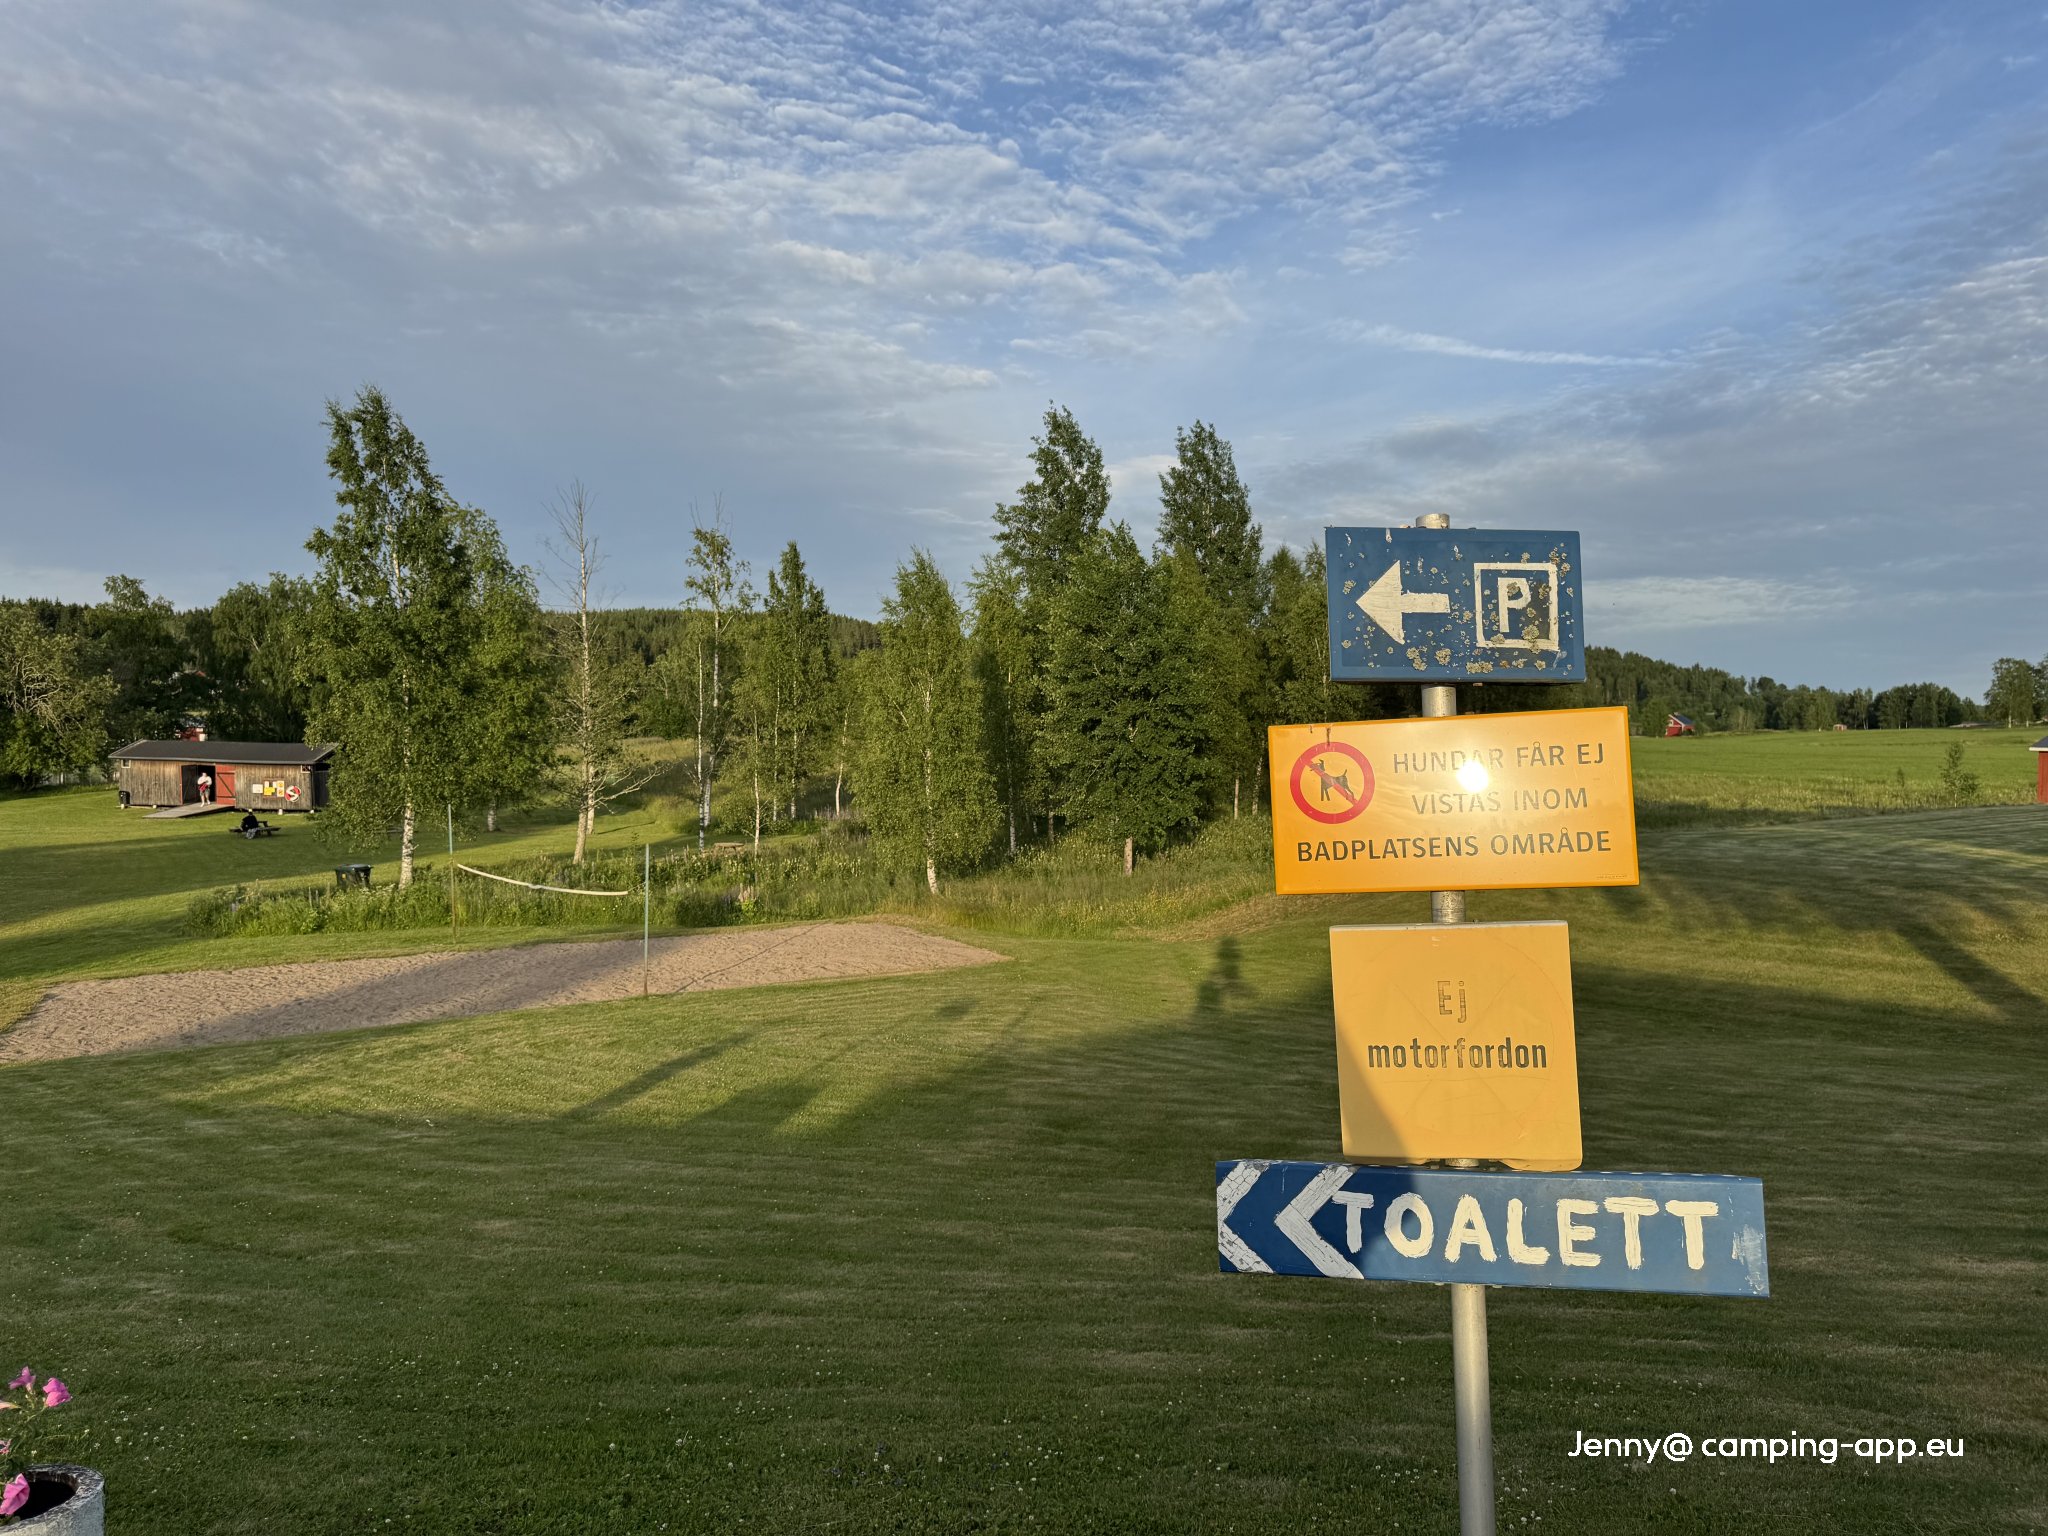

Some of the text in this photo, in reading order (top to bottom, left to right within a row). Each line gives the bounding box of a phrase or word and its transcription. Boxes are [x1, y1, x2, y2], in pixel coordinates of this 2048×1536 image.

[1498, 577, 1531, 632] P
[1516, 741, 1565, 767] FÅR
[1577, 743, 1604, 765] EJ
[1412, 787, 1588, 814] VISTAS INOM
[1297, 827, 1611, 862] BADPLATSENS OMRÅDE
[1437, 980, 1467, 1023] Ej
[1367, 1037, 1547, 1069] motorfordon
[1331, 1192, 1719, 1270] TOALETT
